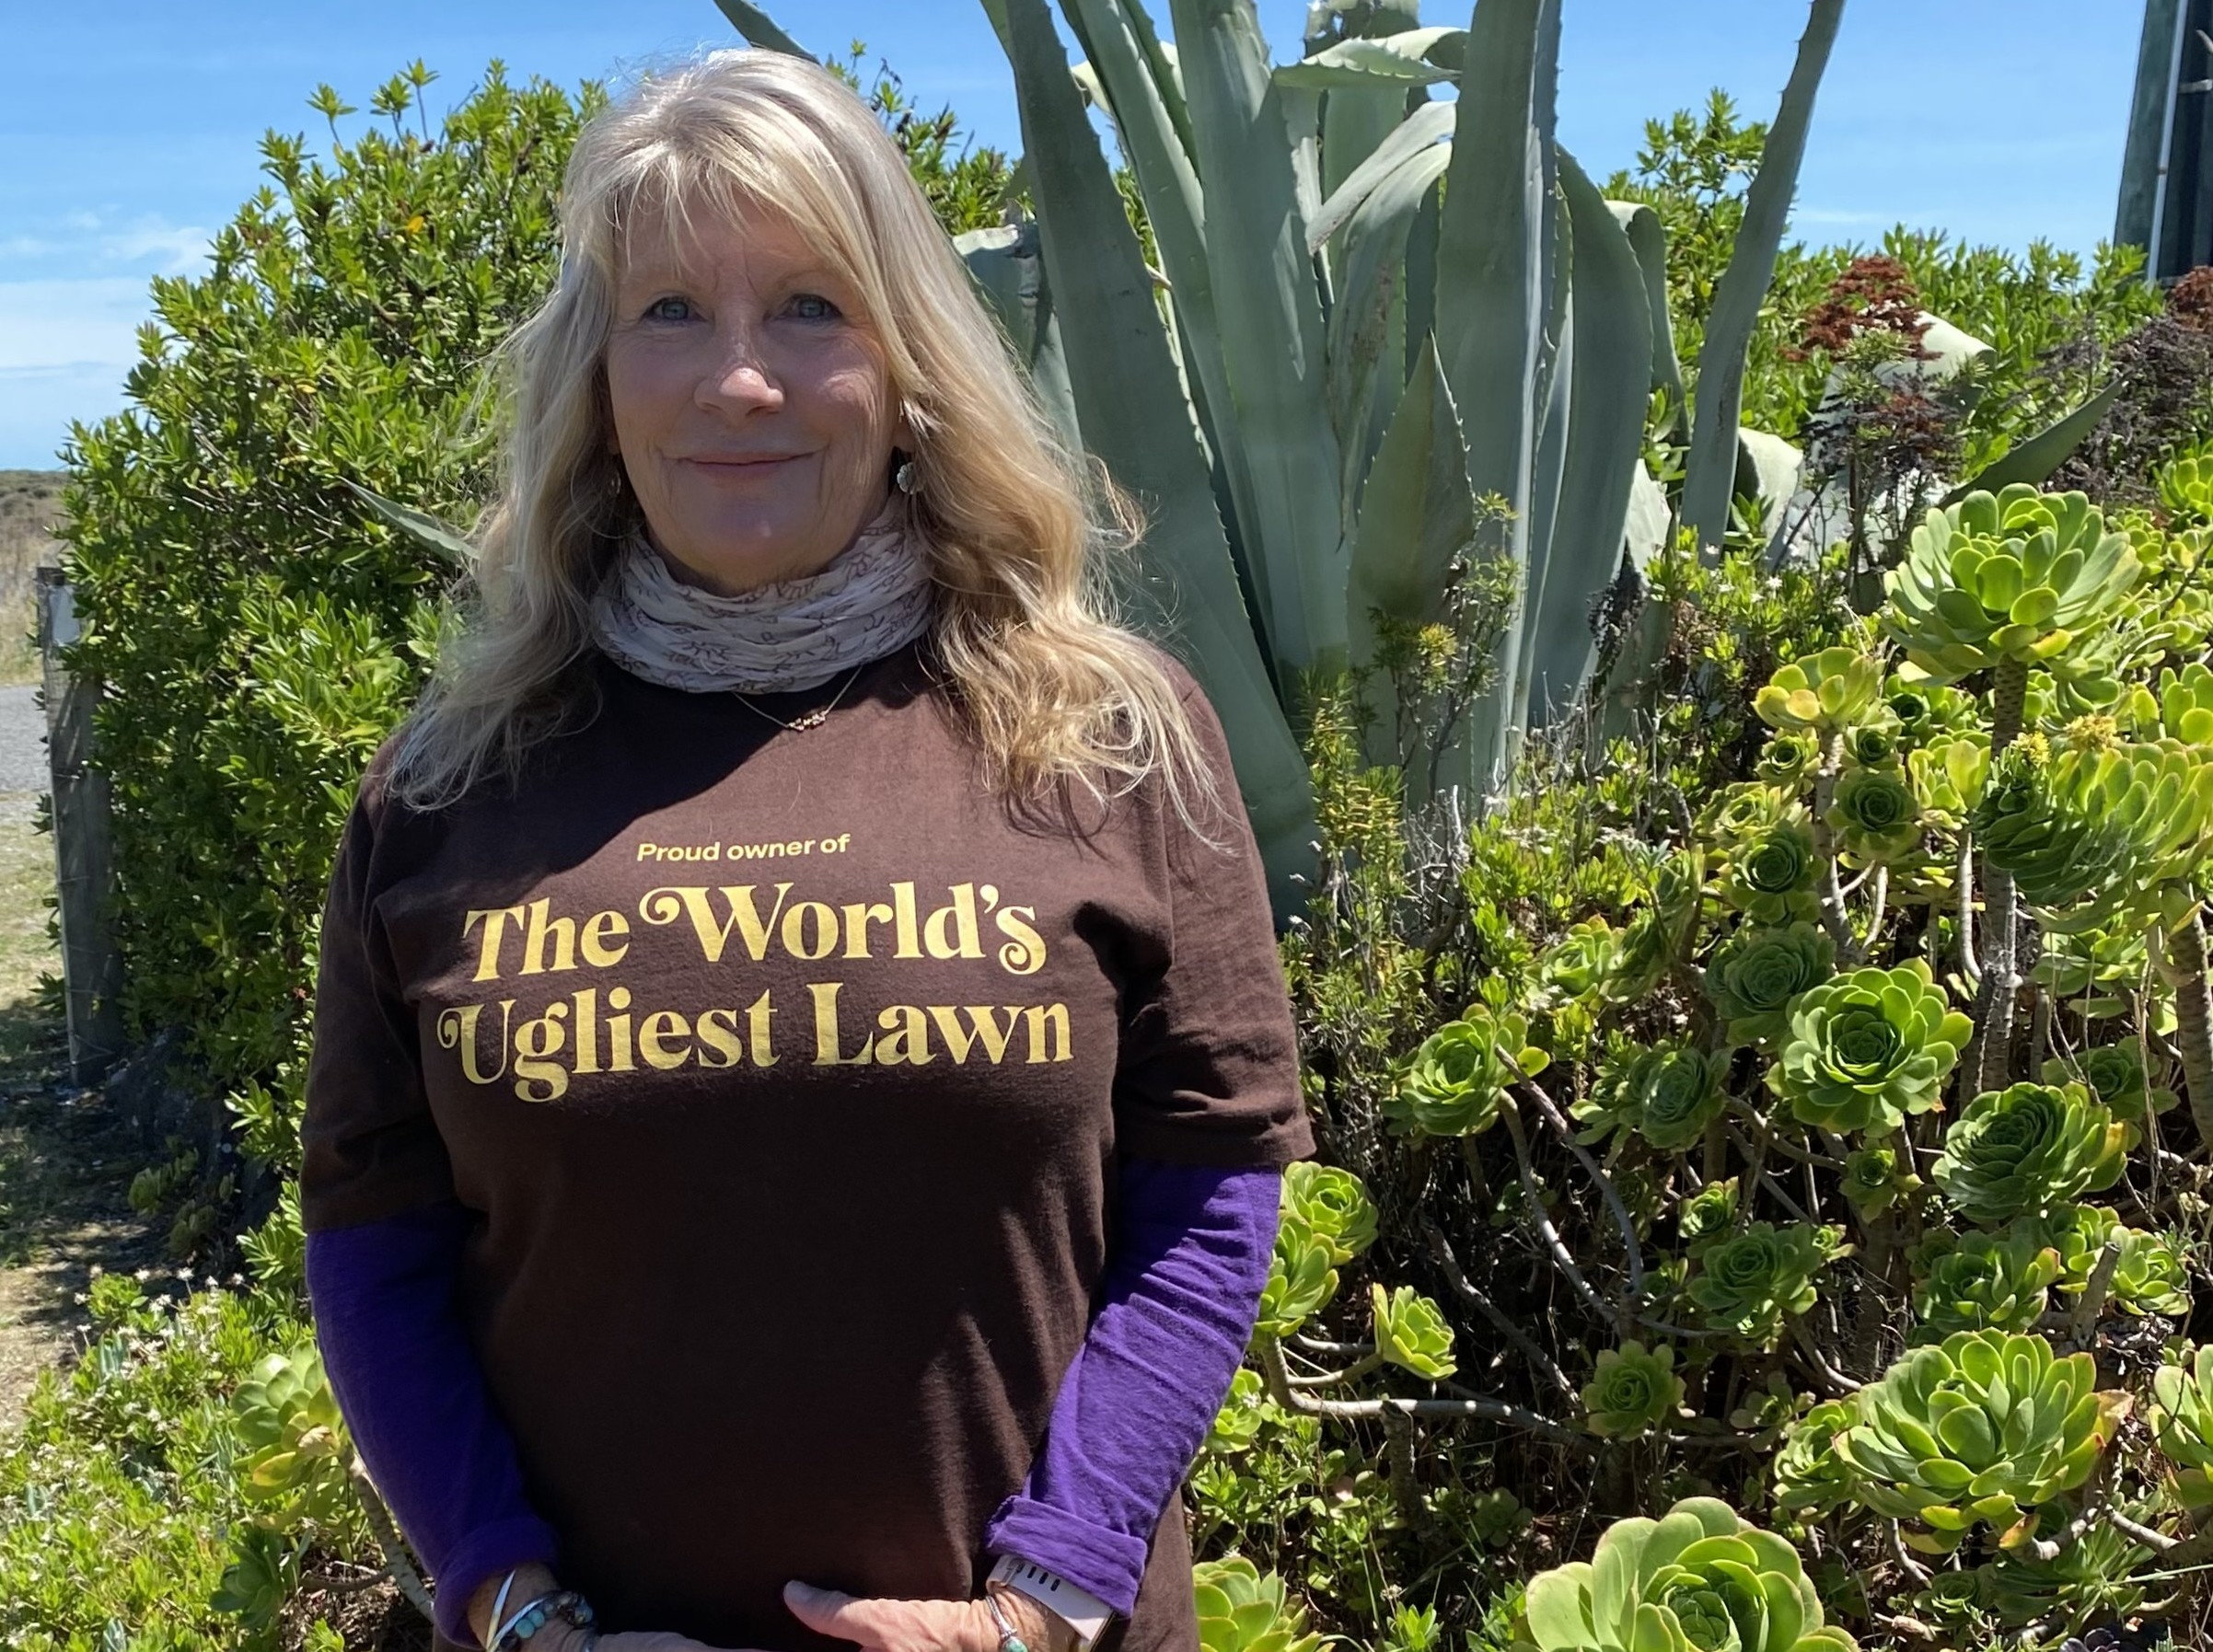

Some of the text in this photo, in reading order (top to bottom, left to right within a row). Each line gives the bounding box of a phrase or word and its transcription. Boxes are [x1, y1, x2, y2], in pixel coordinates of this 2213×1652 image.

[637, 833, 852, 862] Proud owner of
[463, 881, 1047, 983] The World’s
[436, 982, 1074, 1103] Ugliest Lawn
